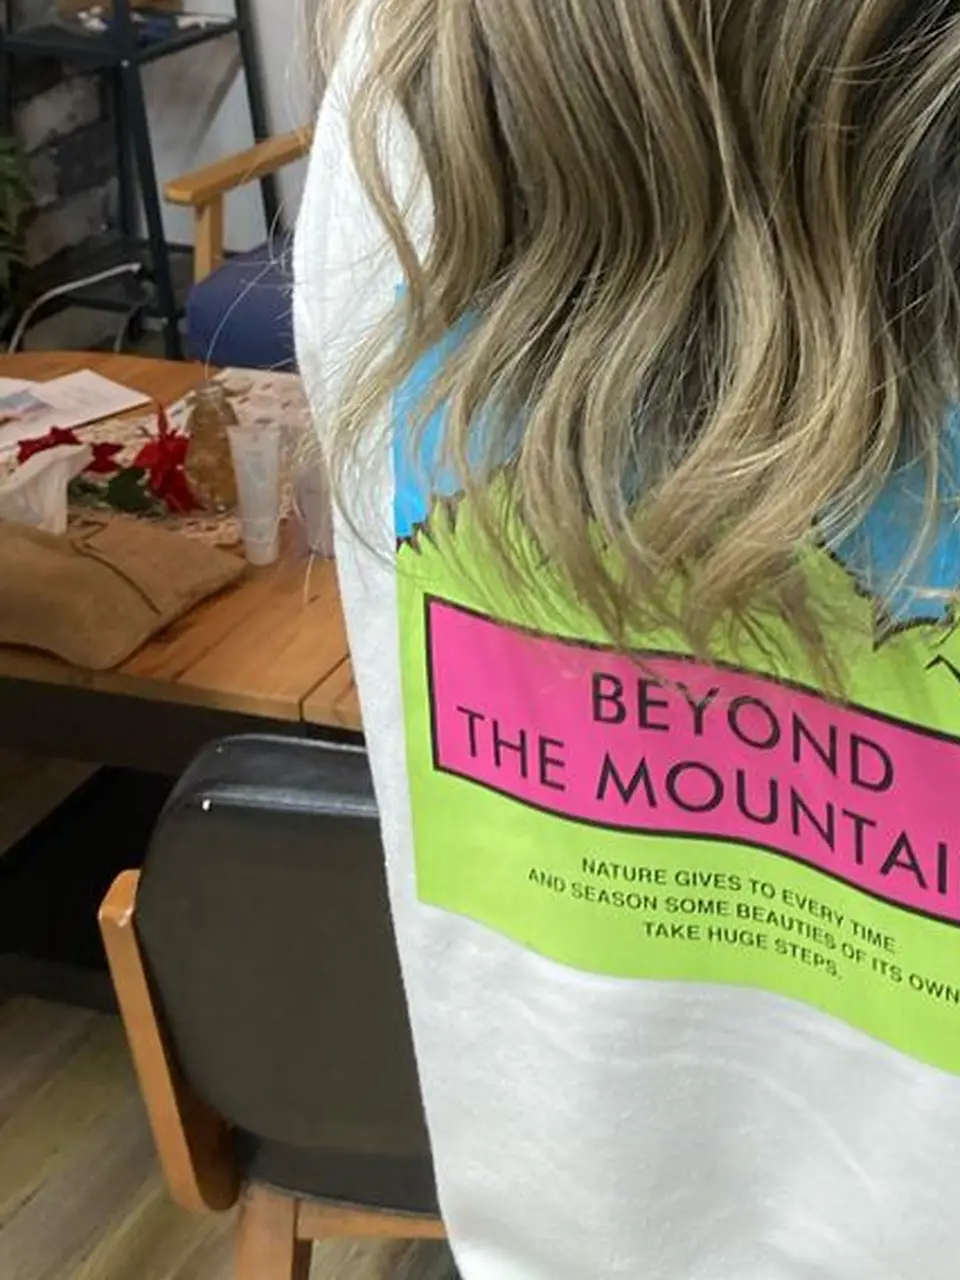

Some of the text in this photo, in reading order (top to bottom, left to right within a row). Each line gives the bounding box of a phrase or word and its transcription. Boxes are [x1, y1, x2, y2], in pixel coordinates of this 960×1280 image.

[456, 706, 566, 791] THE
[592, 672, 893, 793] BEYOND
[528, 868, 960, 1005] AND SEASON SOME BEAUTIES OF ITS OWN
[582, 858, 896, 953] NATURE GIVES TO EVERY TIME
[643, 922, 701, 941] TAKE
[708, 927, 768, 950] HUGE
